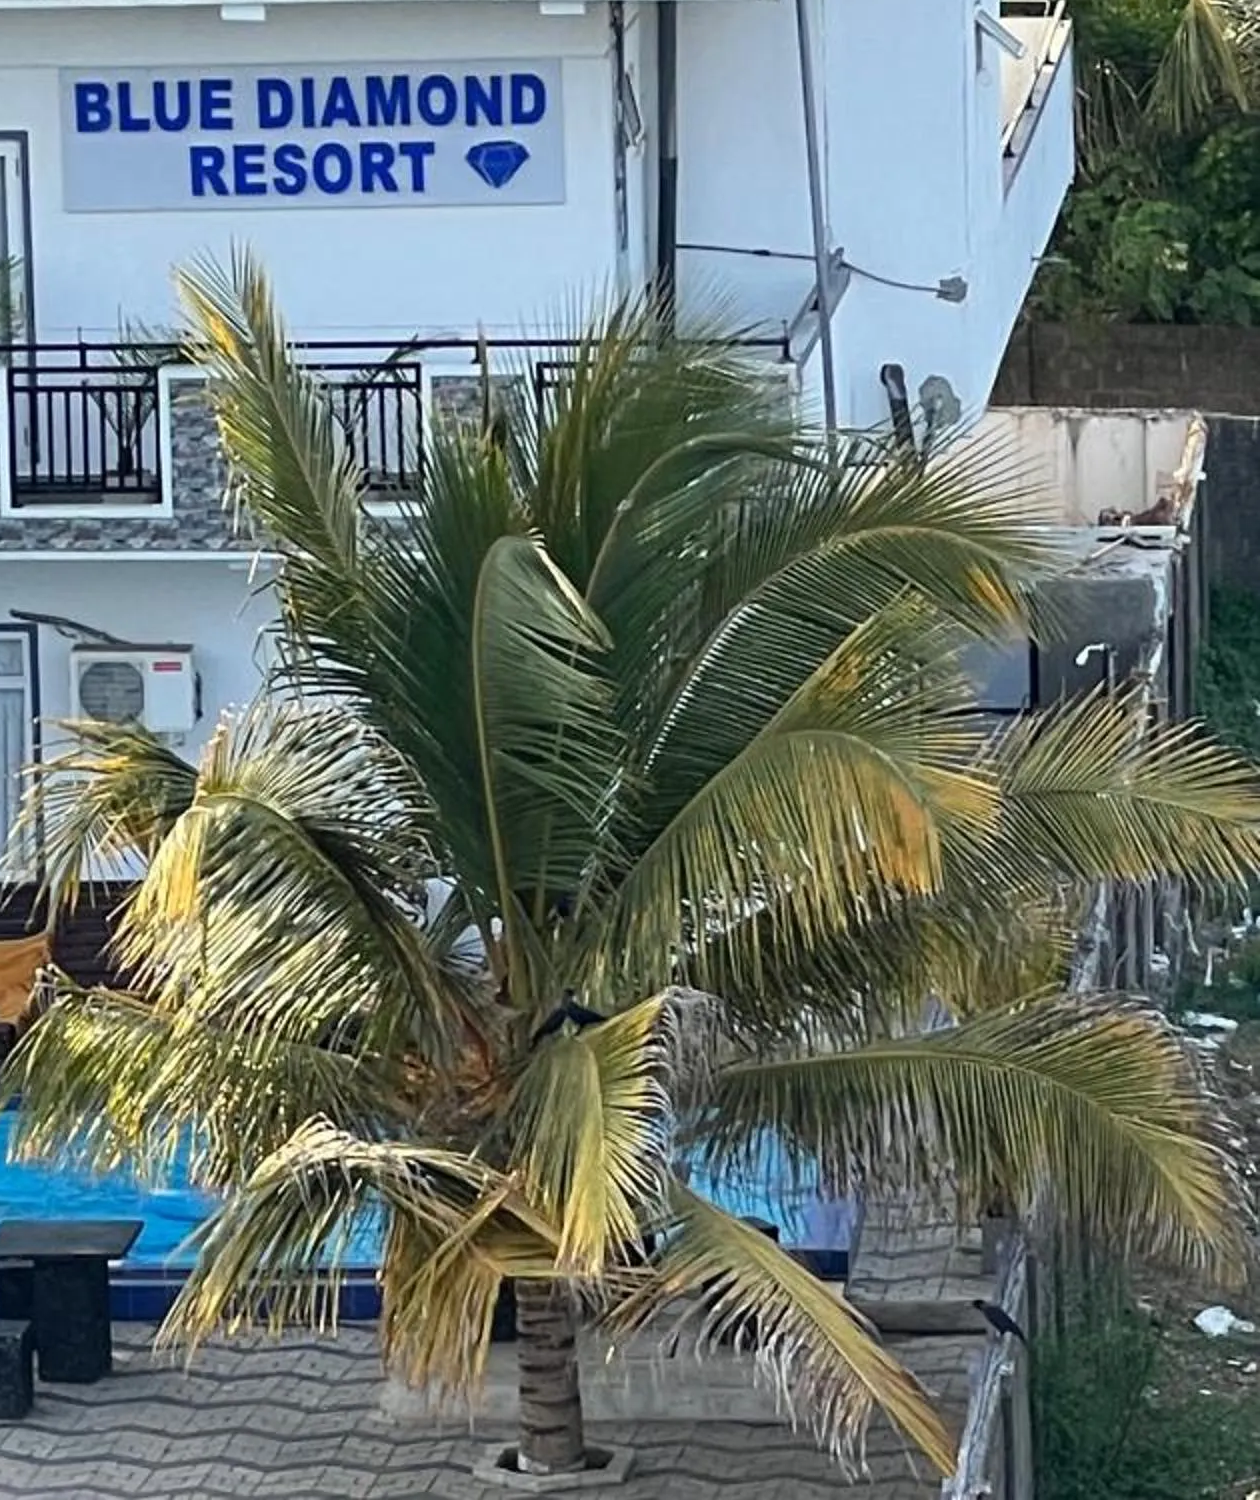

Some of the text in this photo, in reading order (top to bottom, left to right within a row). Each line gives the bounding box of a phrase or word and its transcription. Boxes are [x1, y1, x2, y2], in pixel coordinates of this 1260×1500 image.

[74, 73, 547, 134] BLUE DIAMOND
[189, 141, 436, 197] RESORT
